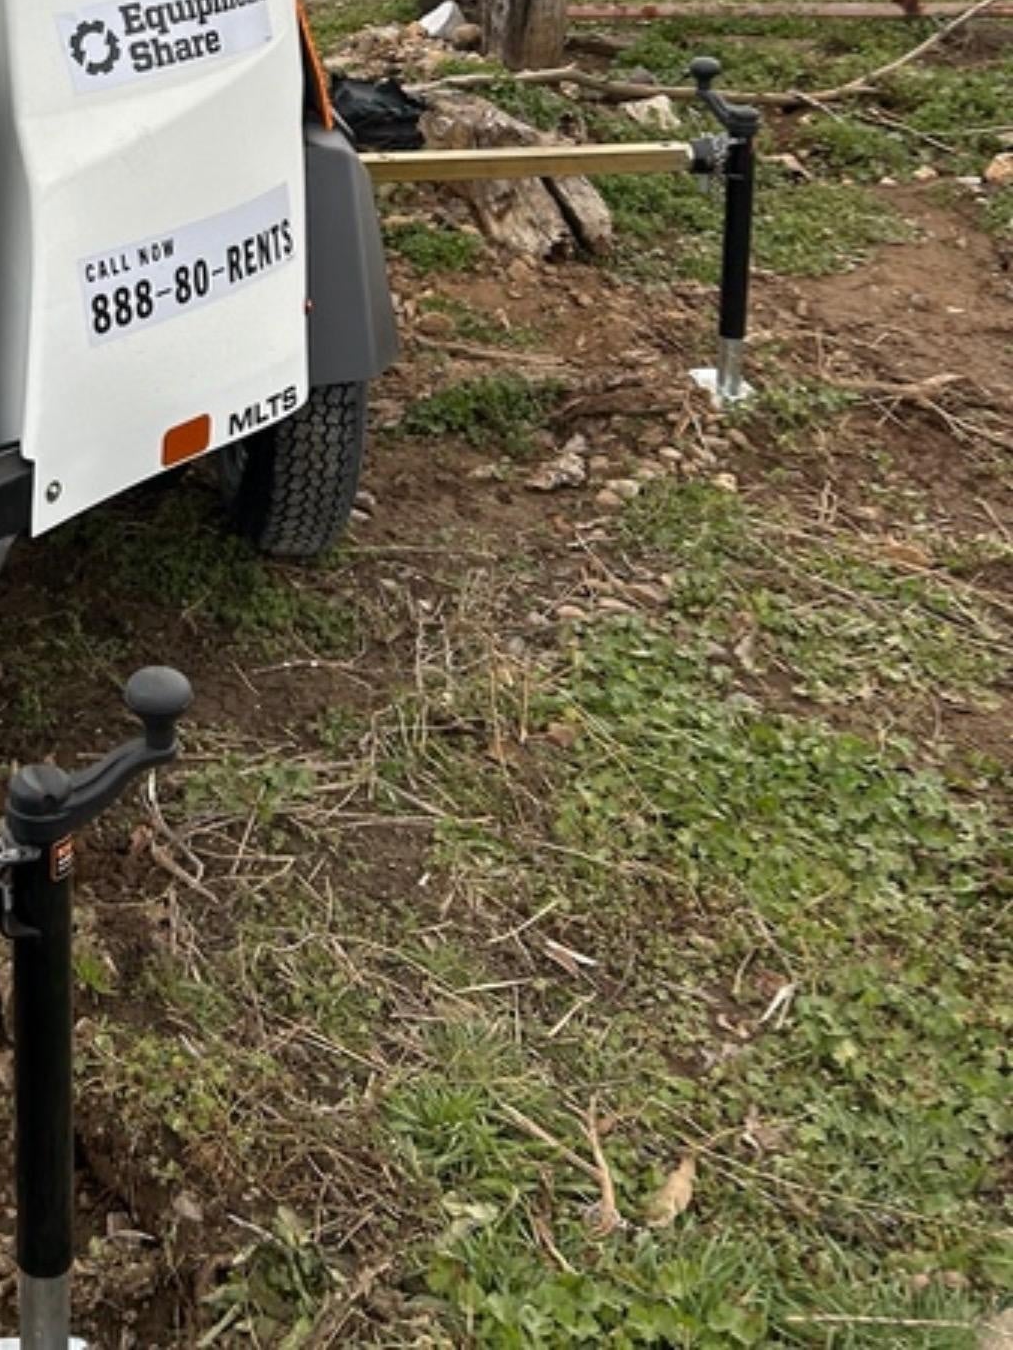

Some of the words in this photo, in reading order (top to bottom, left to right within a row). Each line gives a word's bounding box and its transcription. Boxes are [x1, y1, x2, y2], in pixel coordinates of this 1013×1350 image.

[128, 29, 222, 73] Share
[85, 254, 131, 283] CALL
[138, 237, 175, 266] NOW
[91, 218, 295, 334] 888-80-RENTS
[229, 385, 298, 436] MLTS
